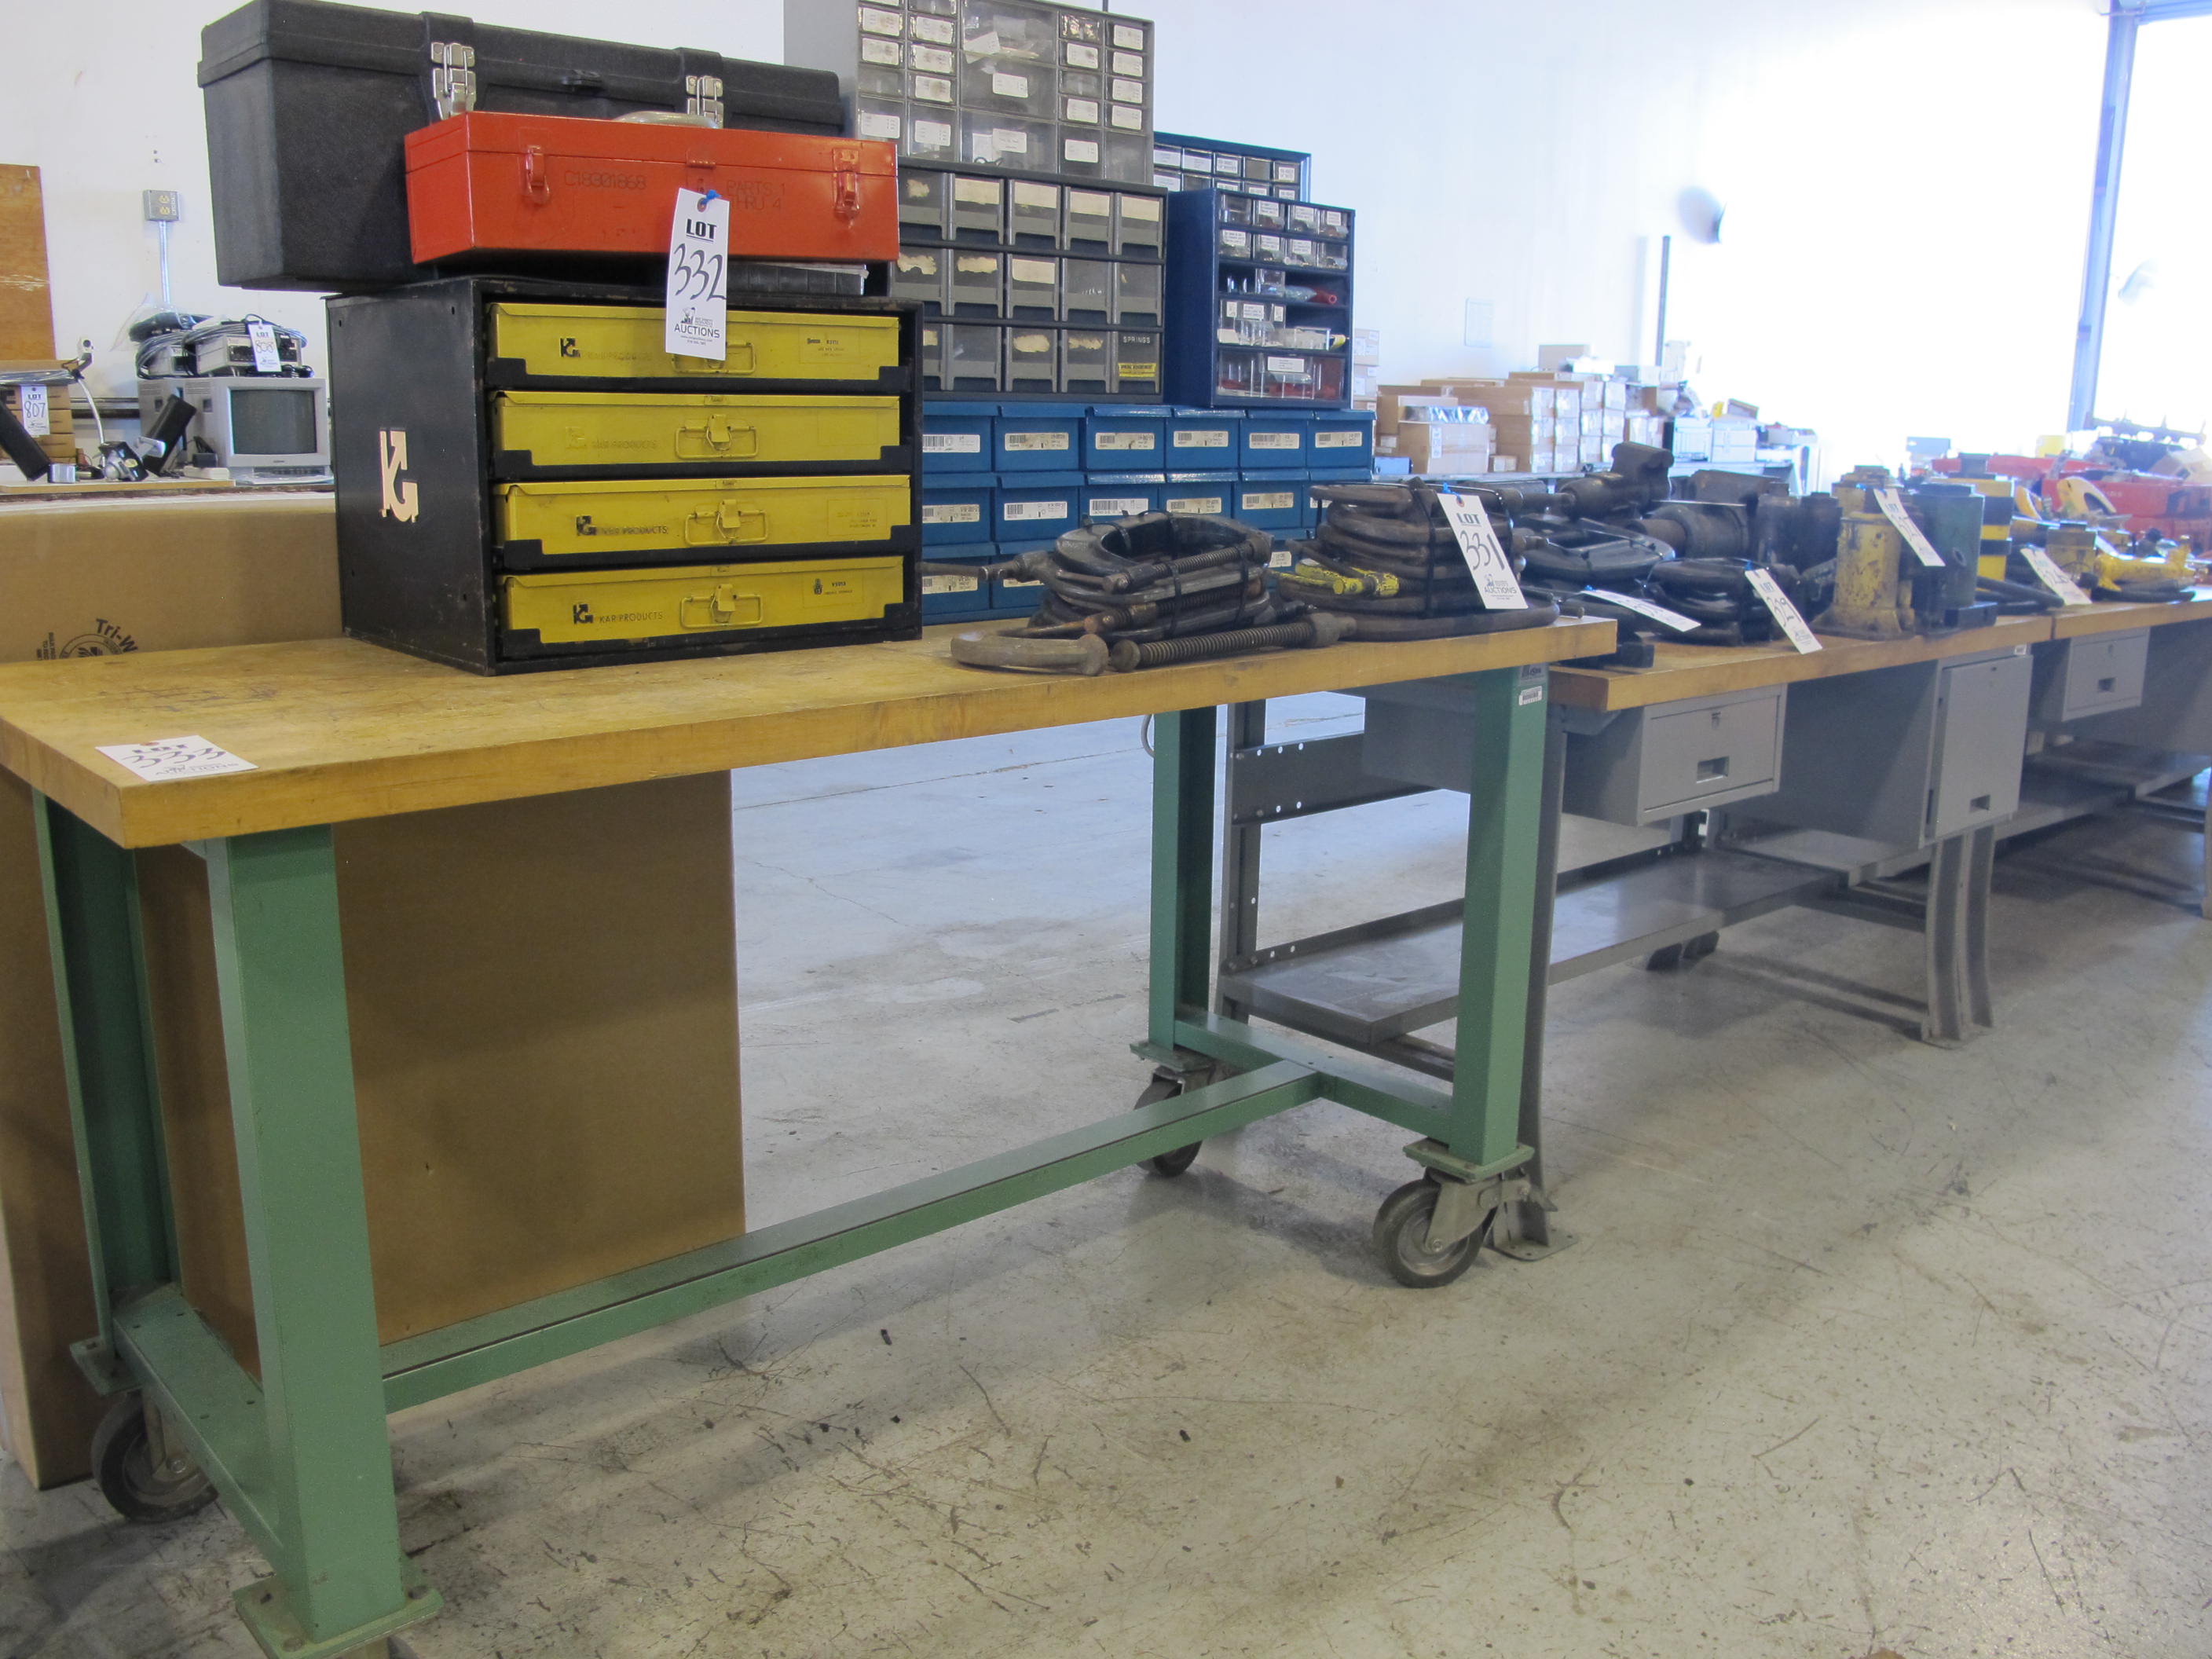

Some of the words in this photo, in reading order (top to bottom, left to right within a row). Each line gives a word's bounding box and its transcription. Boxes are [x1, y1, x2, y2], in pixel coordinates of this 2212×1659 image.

[727, 179, 774, 196] PARTS
[779, 182, 786, 196] 1
[772, 196, 782, 211] 4
[686, 218, 717, 240] LOT
[674, 243, 727, 302] 332
[674, 323, 720, 339] AUCTIONS
[1122, 335, 1151, 344] SPRINGS
[24, 401, 46, 418] 807
[1456, 512, 1481, 525] LOT
[1460, 530, 1505, 571] 331
[599, 614, 616, 623] KAR
[617, 611, 664, 622] PRODUCTS
[122, 748, 227, 768] 333
